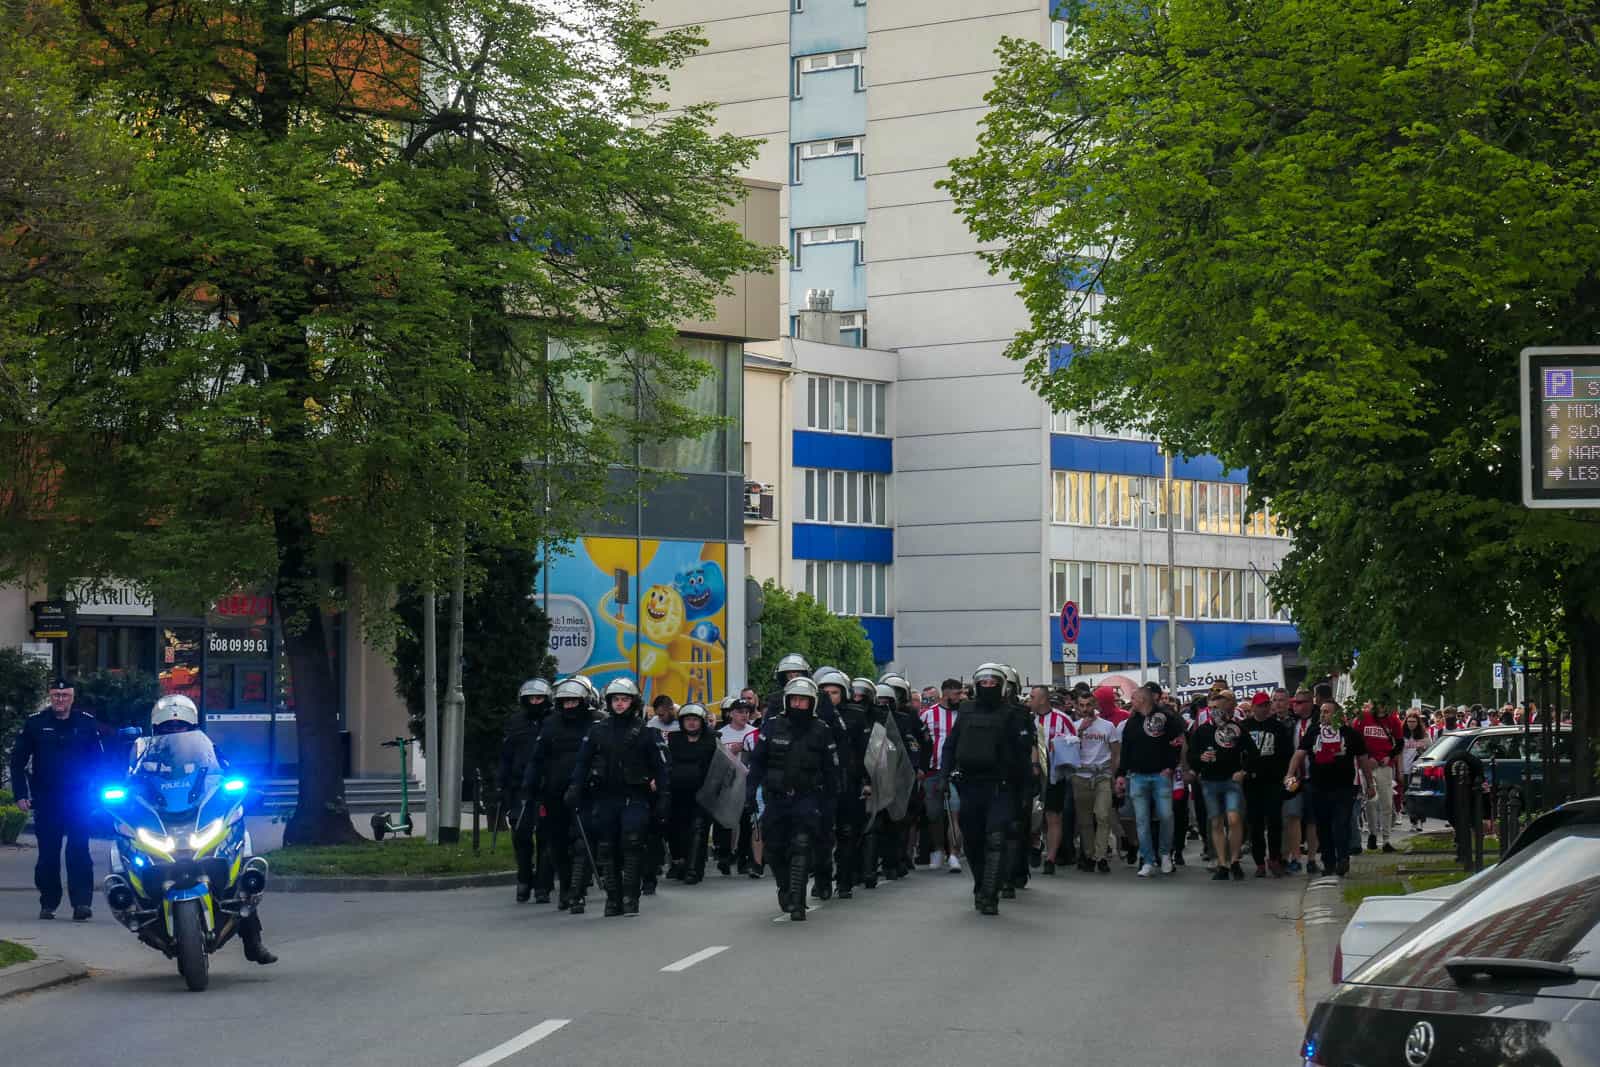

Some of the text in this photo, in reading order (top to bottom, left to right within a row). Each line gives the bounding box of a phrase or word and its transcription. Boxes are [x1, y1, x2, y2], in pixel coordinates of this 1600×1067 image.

[1568, 466, 1600, 481] LES
[210, 639, 269, 653] 608 09 99 61
[551, 632, 588, 650] gratis
[1231, 669, 1258, 687] jest
